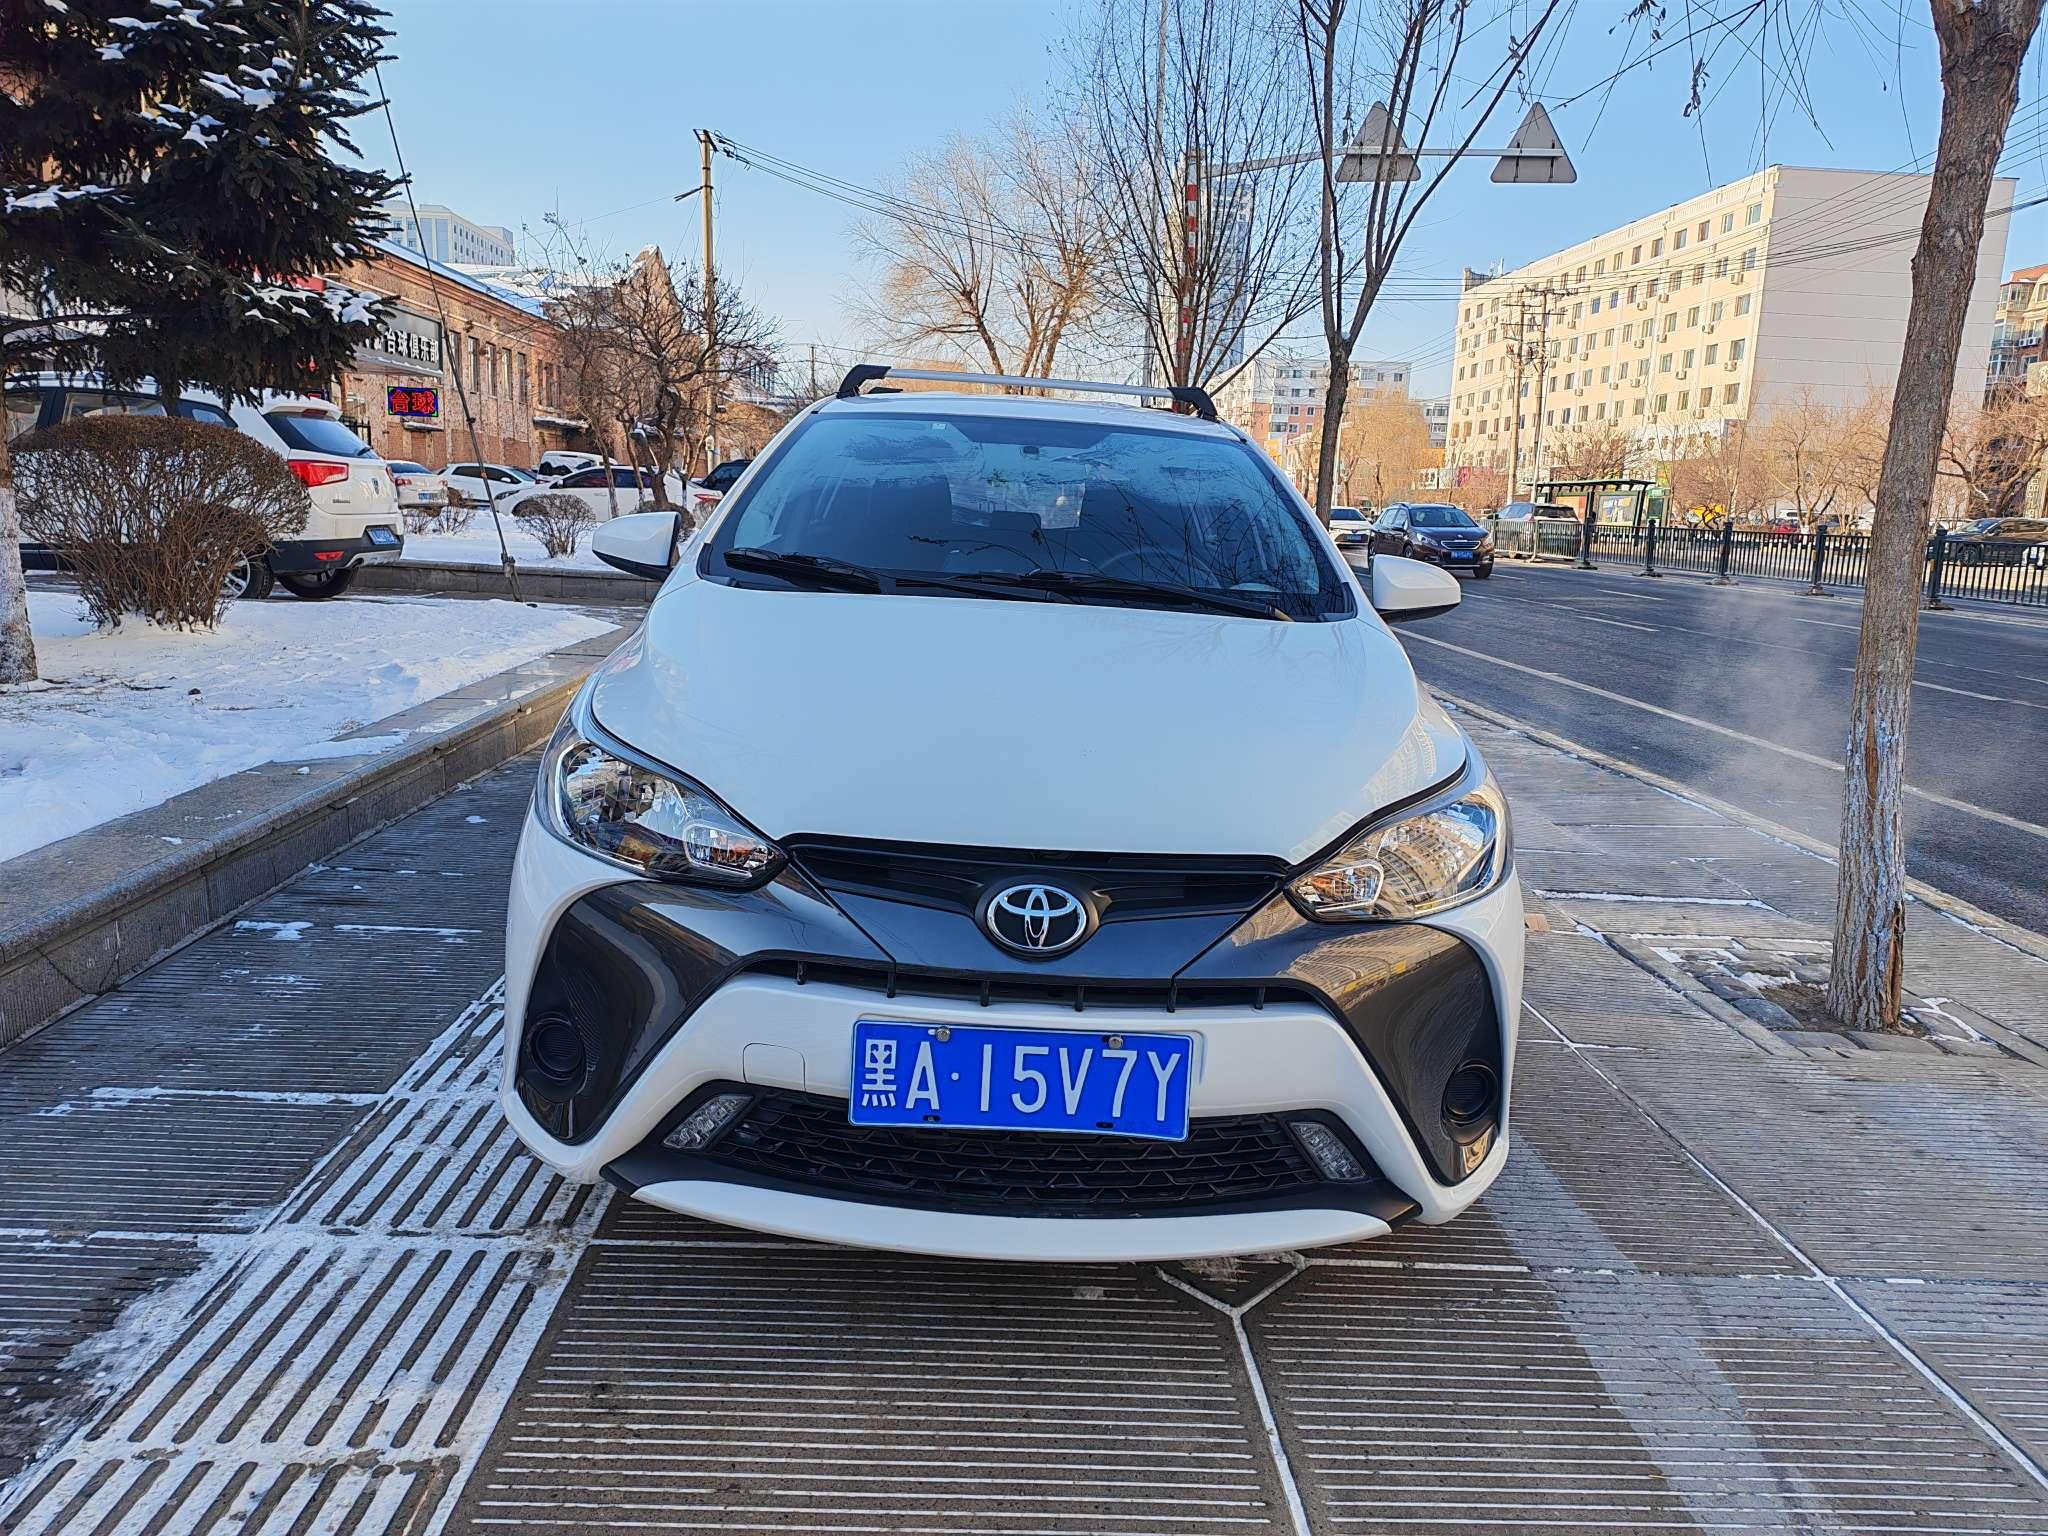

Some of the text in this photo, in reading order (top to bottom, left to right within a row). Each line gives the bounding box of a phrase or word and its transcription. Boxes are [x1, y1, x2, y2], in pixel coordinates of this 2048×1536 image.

[366, 327, 439, 363] 台球俱乐部
[392, 391, 435, 414] 台球
[861, 1039, 1182, 1122] 黑A·15V7Y
